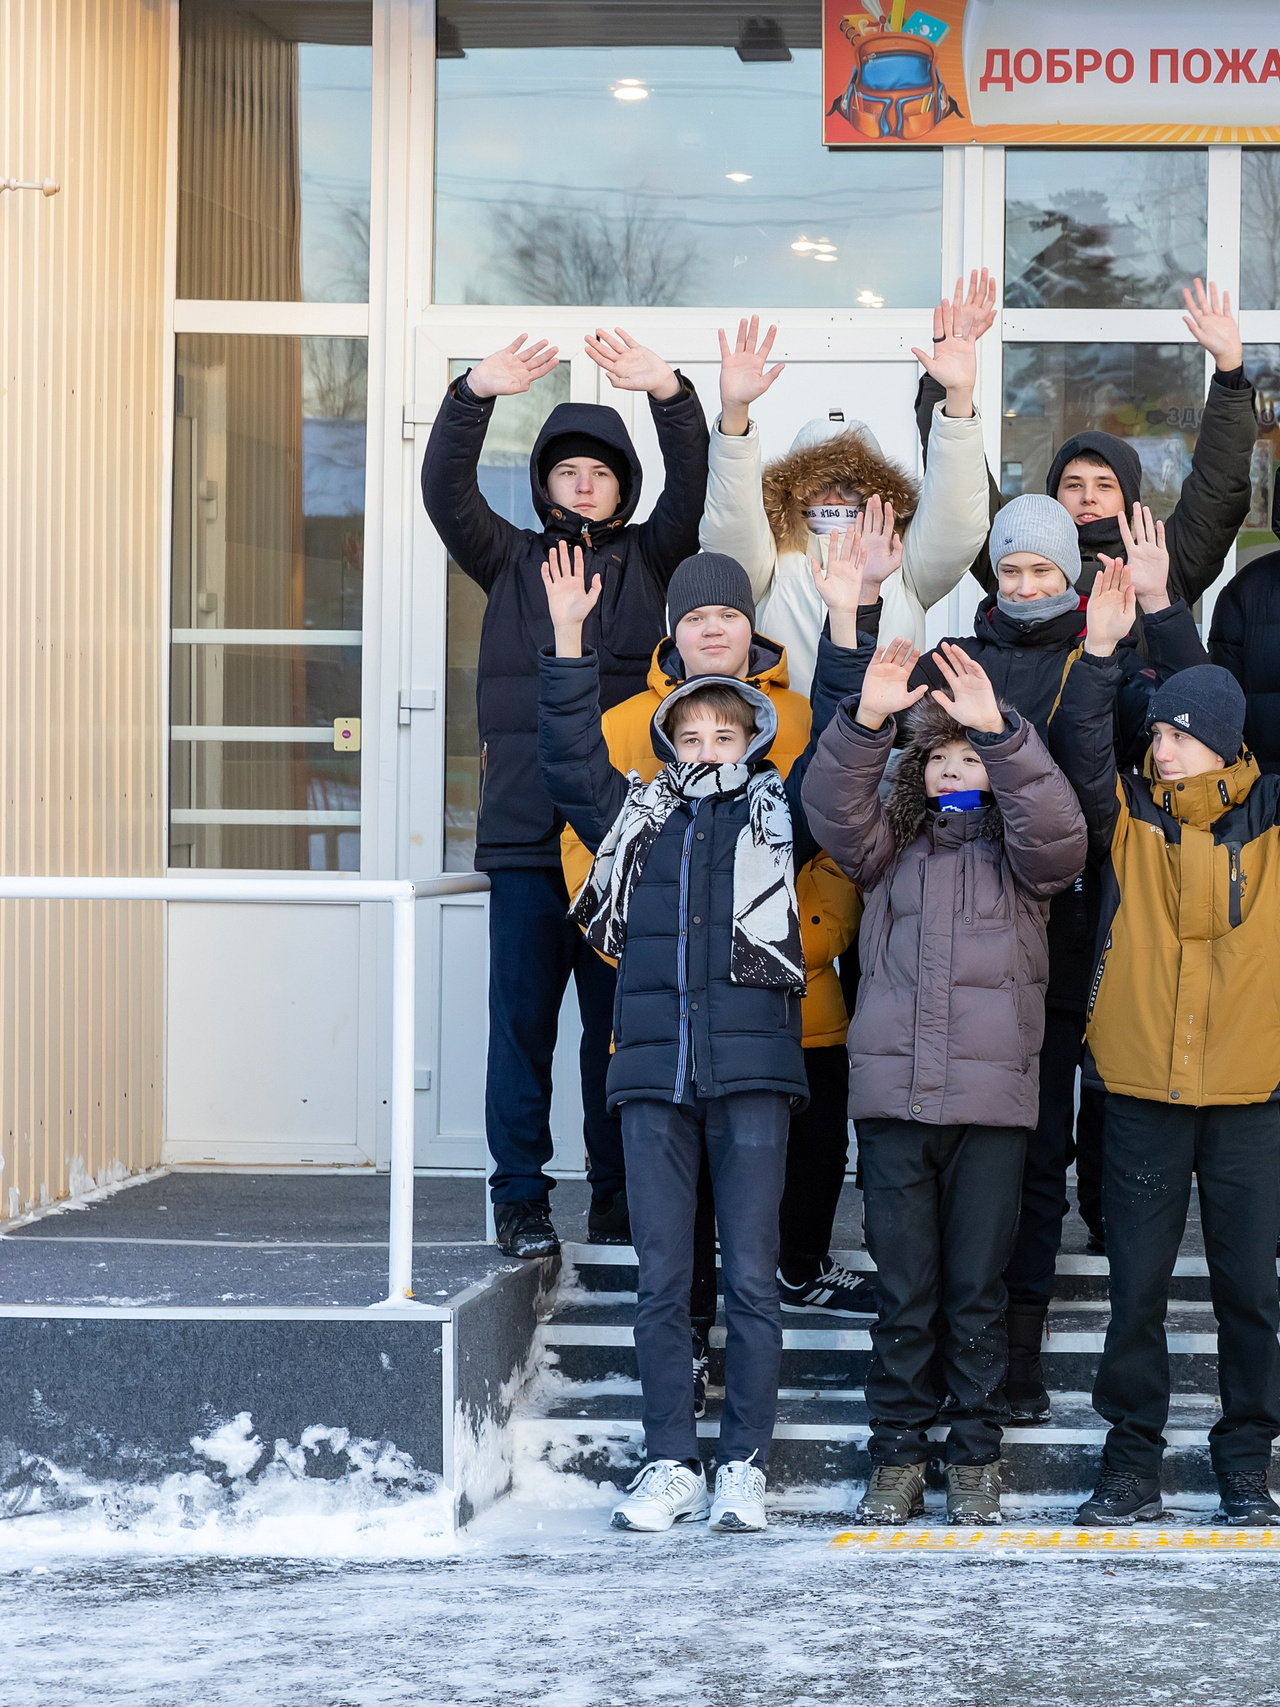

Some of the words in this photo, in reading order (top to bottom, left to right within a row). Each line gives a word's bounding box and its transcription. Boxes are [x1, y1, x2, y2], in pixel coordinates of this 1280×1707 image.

[979, 48, 1134, 92] ДОБРО
[1173, 716, 1190, 728] adidas
[1074, 874, 1083, 892] AM
